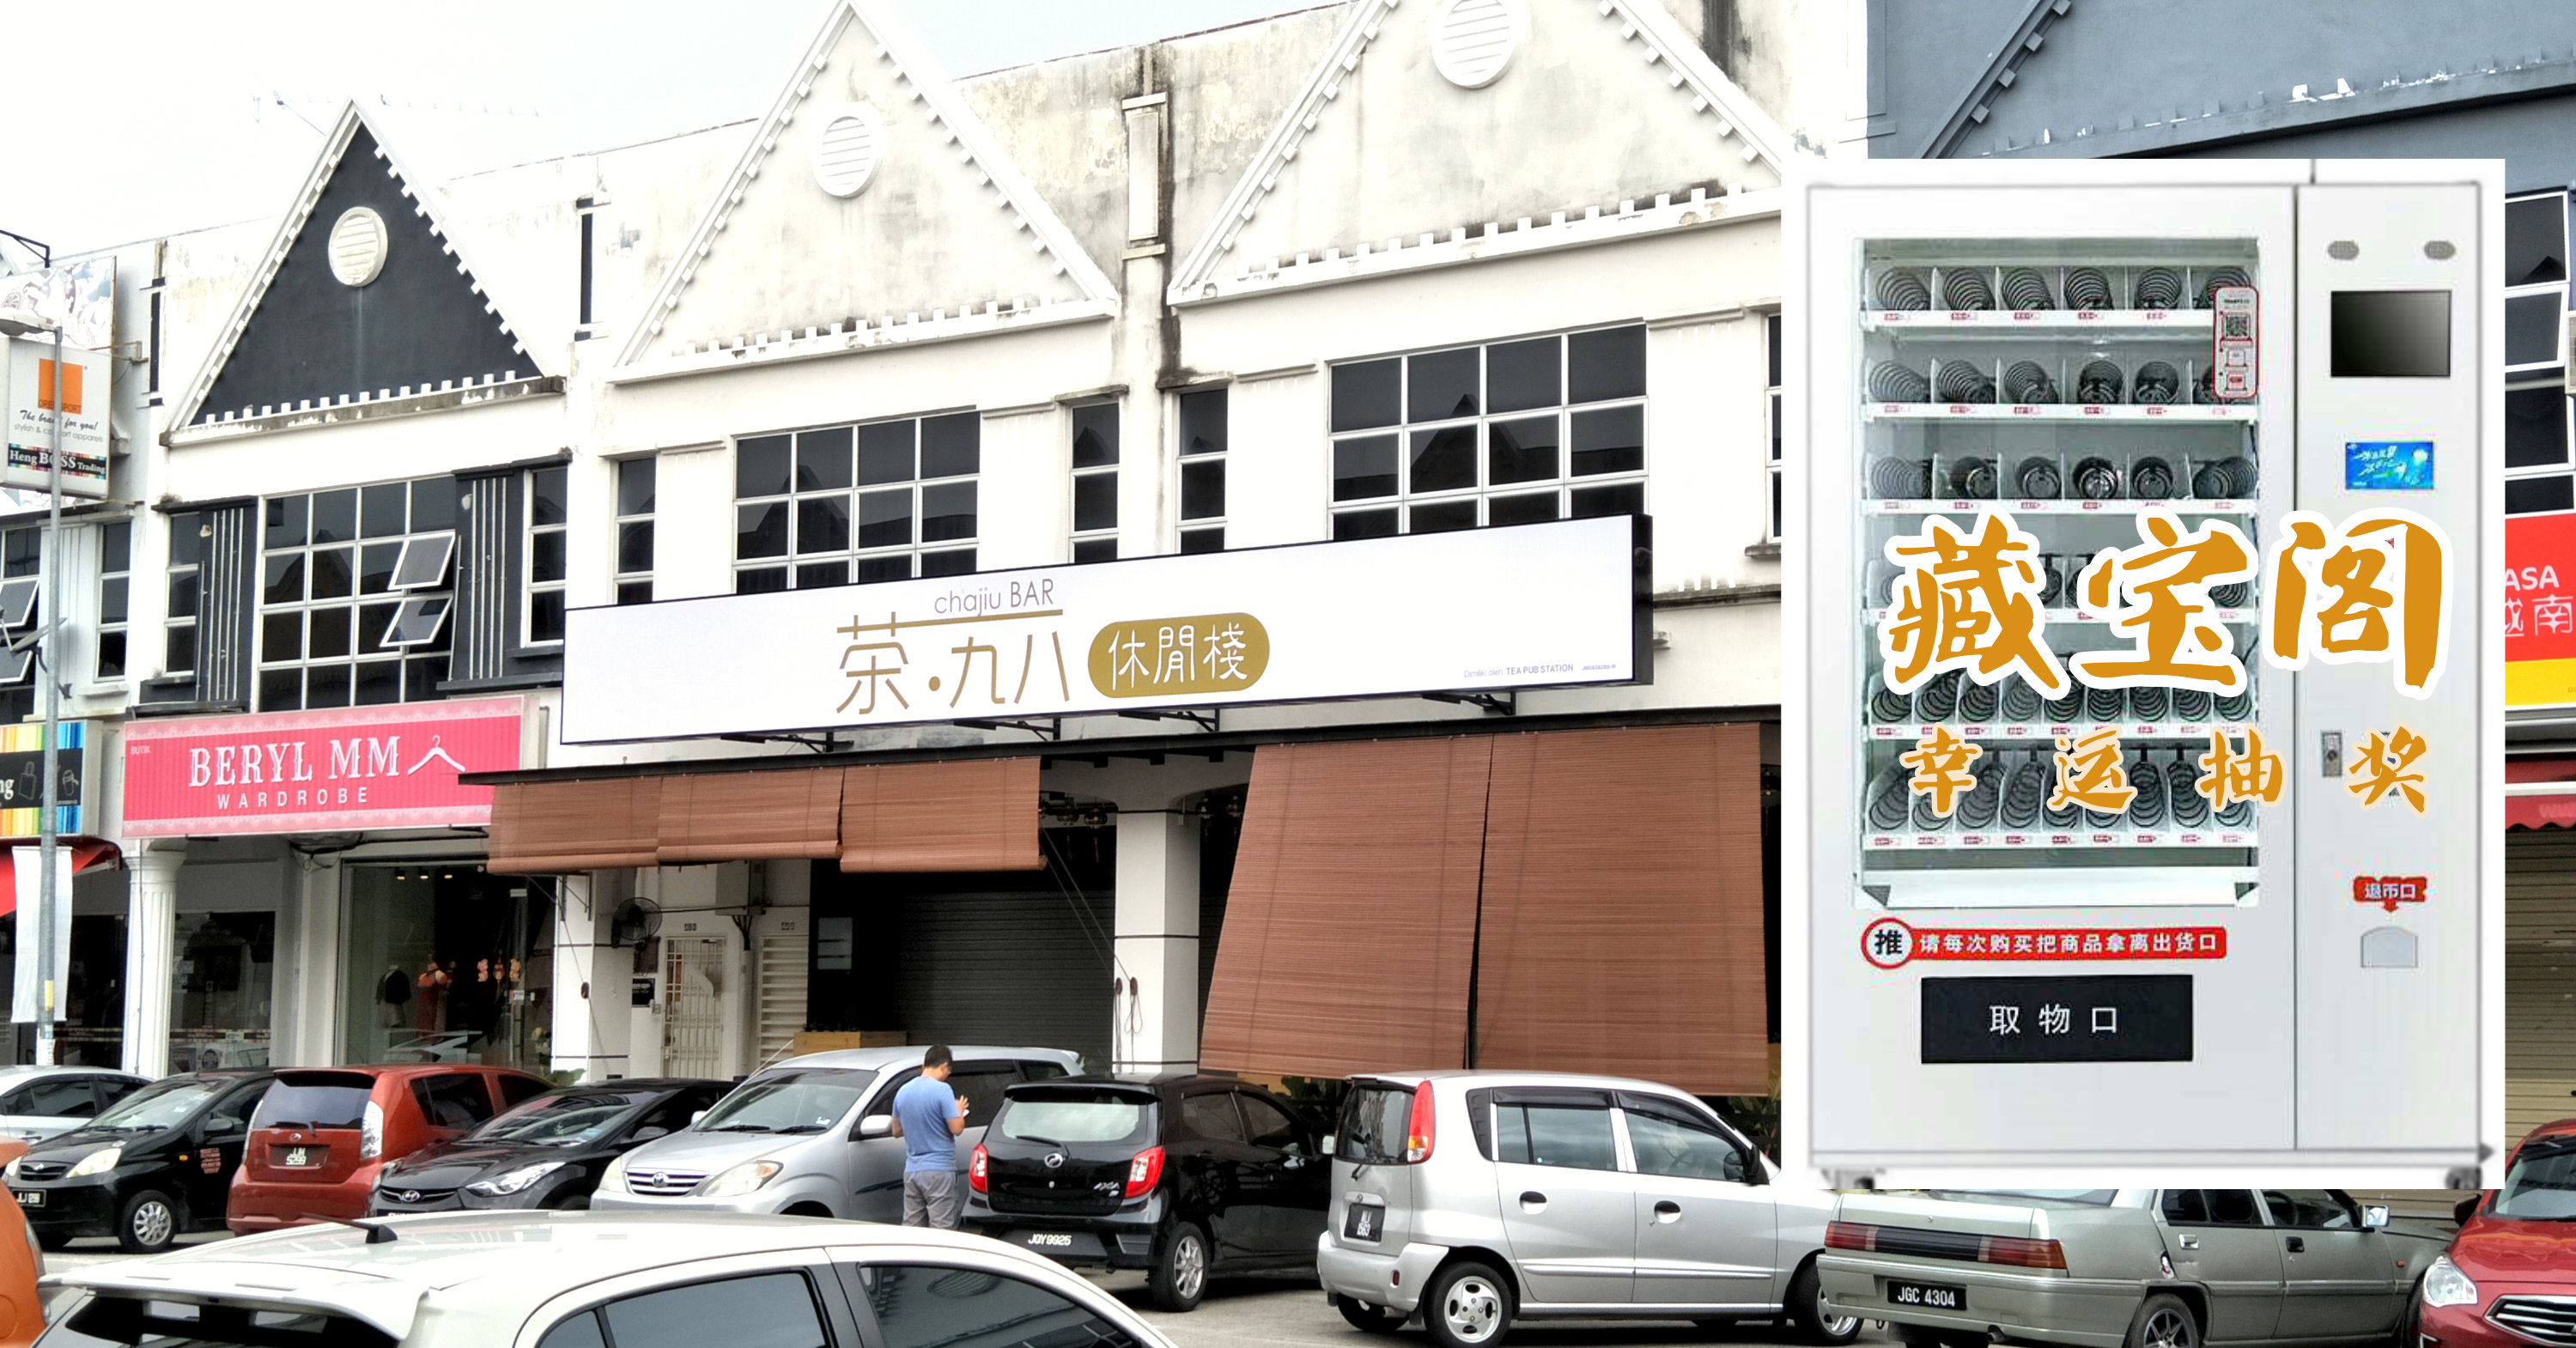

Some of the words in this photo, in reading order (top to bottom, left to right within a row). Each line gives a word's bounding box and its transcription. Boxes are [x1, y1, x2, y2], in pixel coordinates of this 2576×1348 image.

[20, 410, 35, 421] The
[38, 413, 63, 424] bra
[64, 418, 77, 430] for
[80, 421, 99, 430] you!
[9, 450, 38, 466] Heng
[39, 452, 76, 469] BSS
[77, 461, 106, 475] Trading
[934, 589, 1001, 616] chajiu
[1010, 579, 1054, 608] BAR
[1506, 667, 1522, 676] TEA
[1523, 665, 1540, 675] PUB
[1540, 664, 1574, 673] STATION
[131, 745, 150, 756] BUTIK
[188, 741, 313, 787] BERYL
[328, 736, 401, 780] MM
[217, 787, 368, 810] WARDROBE
[1898, 1286, 1920, 1303] JGC
[1924, 1289, 1956, 1307] 4304
